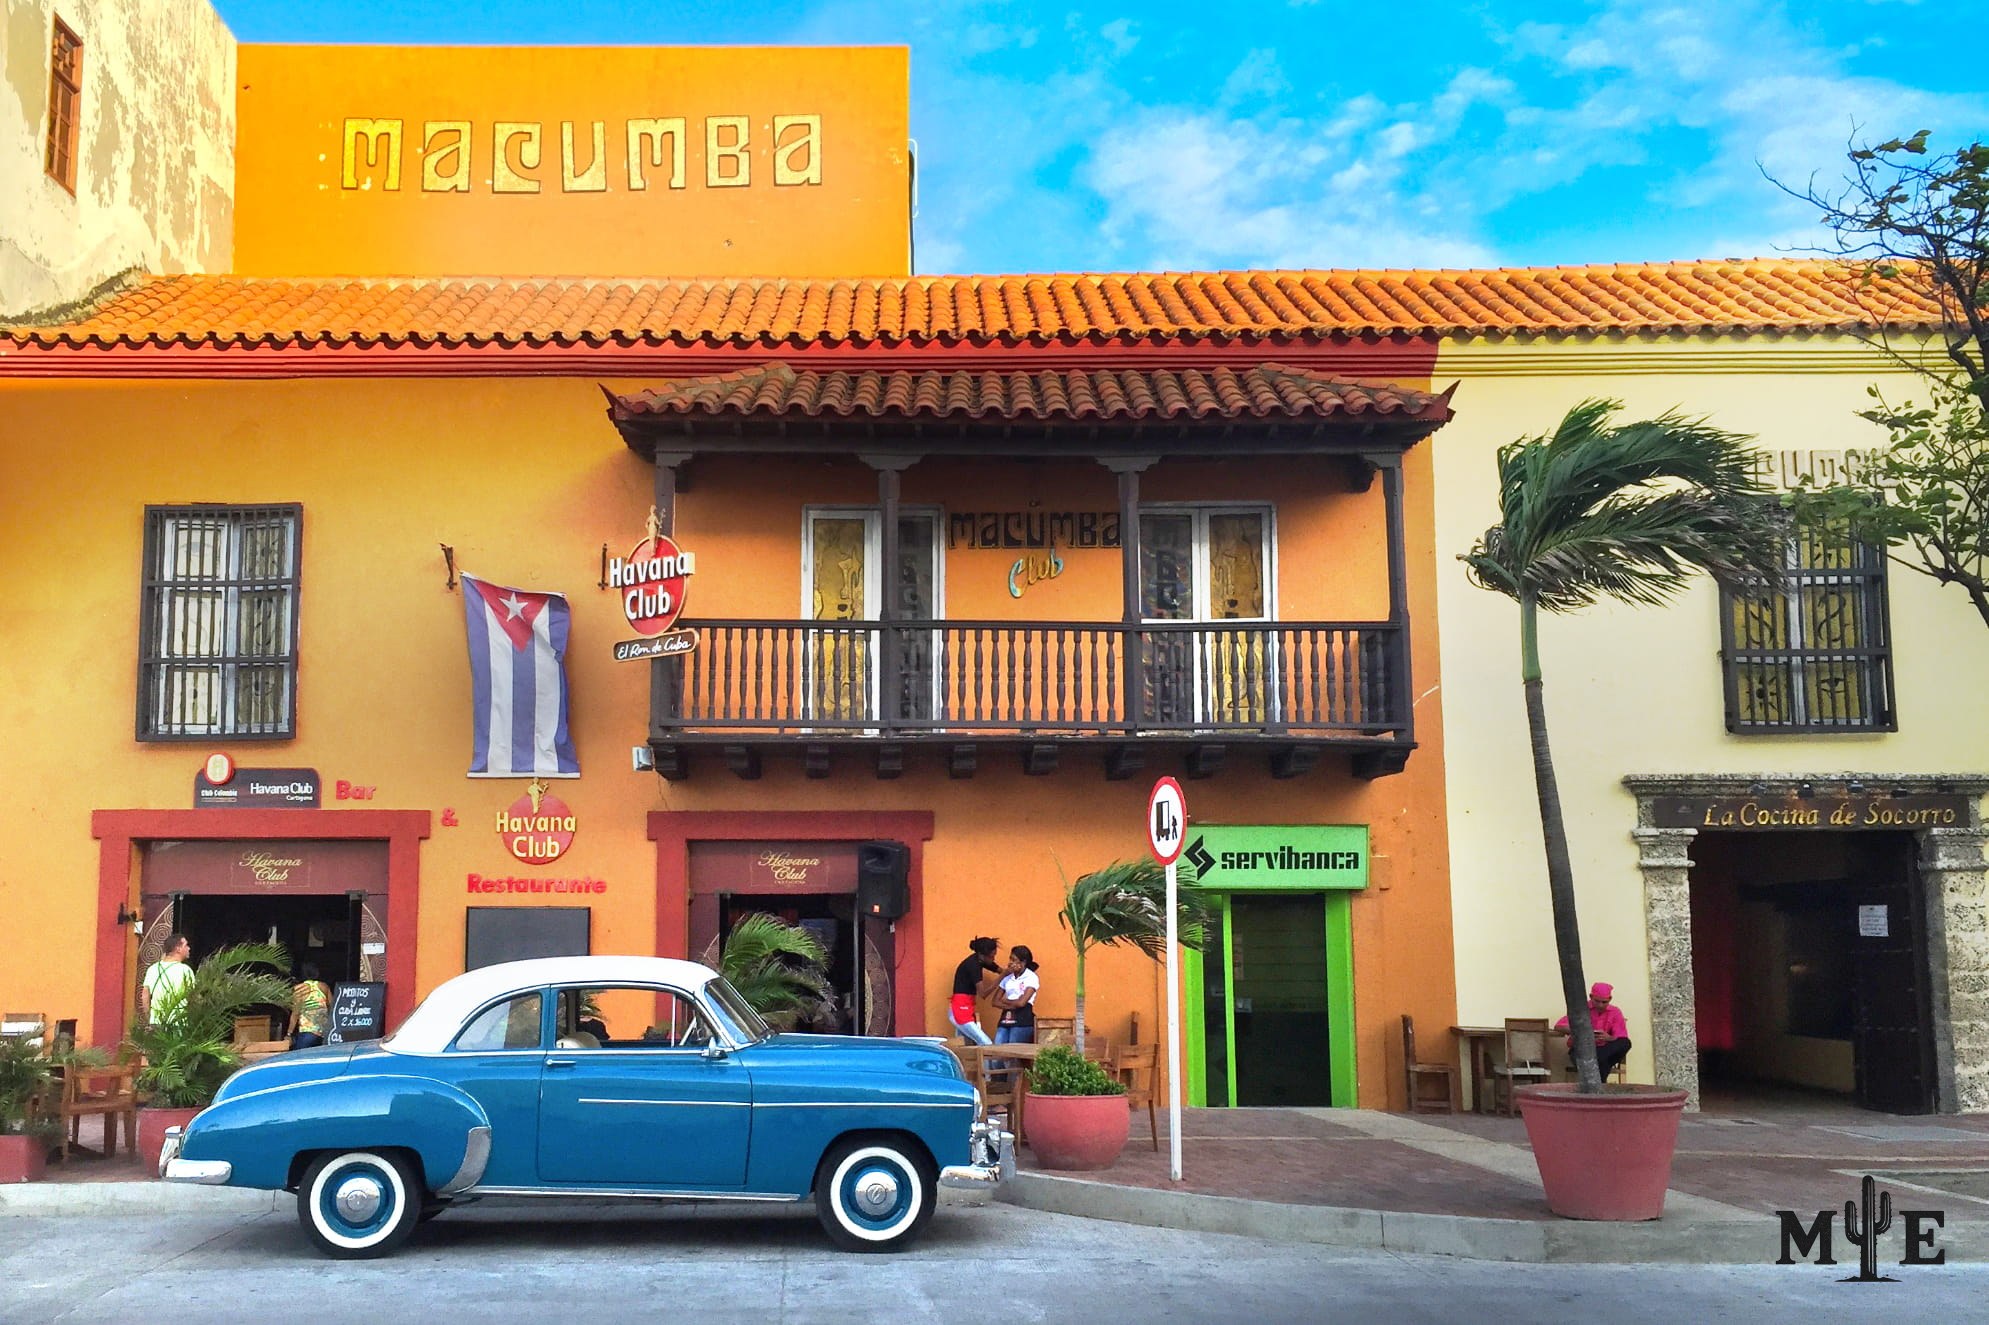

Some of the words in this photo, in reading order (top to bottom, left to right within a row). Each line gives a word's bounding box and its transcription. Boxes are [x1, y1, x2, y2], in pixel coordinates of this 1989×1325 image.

[609, 552, 691, 588] Havana
[1008, 549, 1065, 598] Club
[625, 584, 671, 620] Club
[617, 643, 629, 659] El
[630, 644, 650, 658] Ron
[651, 640, 662, 654] de
[663, 635, 692, 651] Cuba
[250, 782, 289, 794] Havana
[290, 782, 313, 794] Club
[336, 779, 377, 800] Bar
[441, 807, 459, 827] &
[496, 811, 577, 833] Havana
[1703, 804, 1734, 826] La
[1740, 802, 1819, 826] Cocina
[1830, 802, 1857, 825] de
[1864, 802, 1956, 825] Socorro
[512, 835, 560, 858] Club
[239, 849, 303, 867] Havana
[757, 850, 821, 867] Havana
[252, 865, 289, 881] Club
[771, 865, 807, 880] Club
[467, 873, 607, 894] Restaurante
